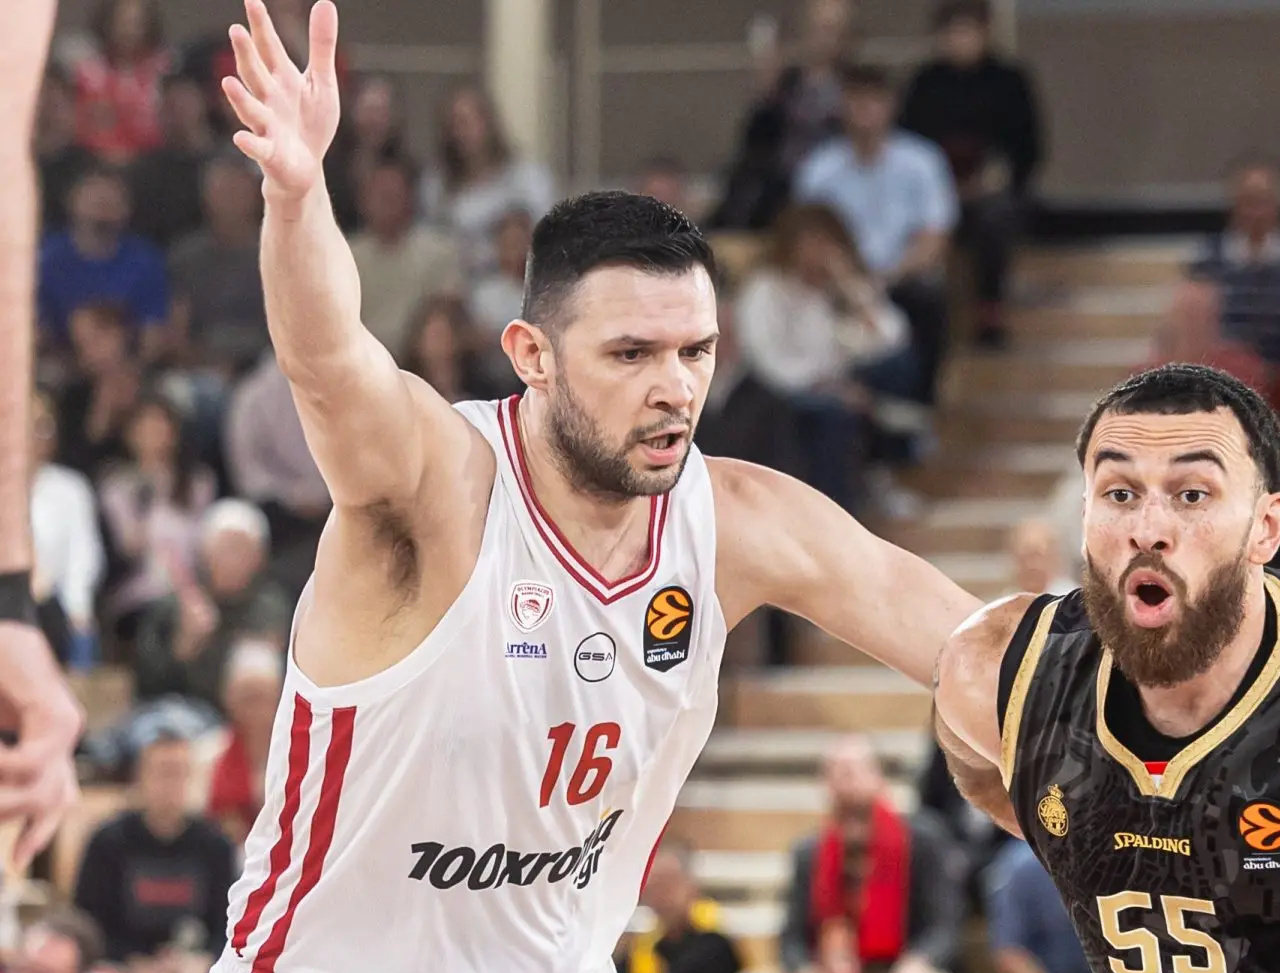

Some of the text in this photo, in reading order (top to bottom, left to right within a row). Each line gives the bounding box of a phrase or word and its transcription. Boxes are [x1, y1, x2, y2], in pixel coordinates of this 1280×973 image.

[579, 652, 613, 661] GSA
[647, 654, 661, 663] abu
[661, 649, 686, 661] dhabi
[540, 721, 622, 808] 16
[1114, 832, 1191, 856] SPALDING
[1243, 861, 1264, 870] abu
